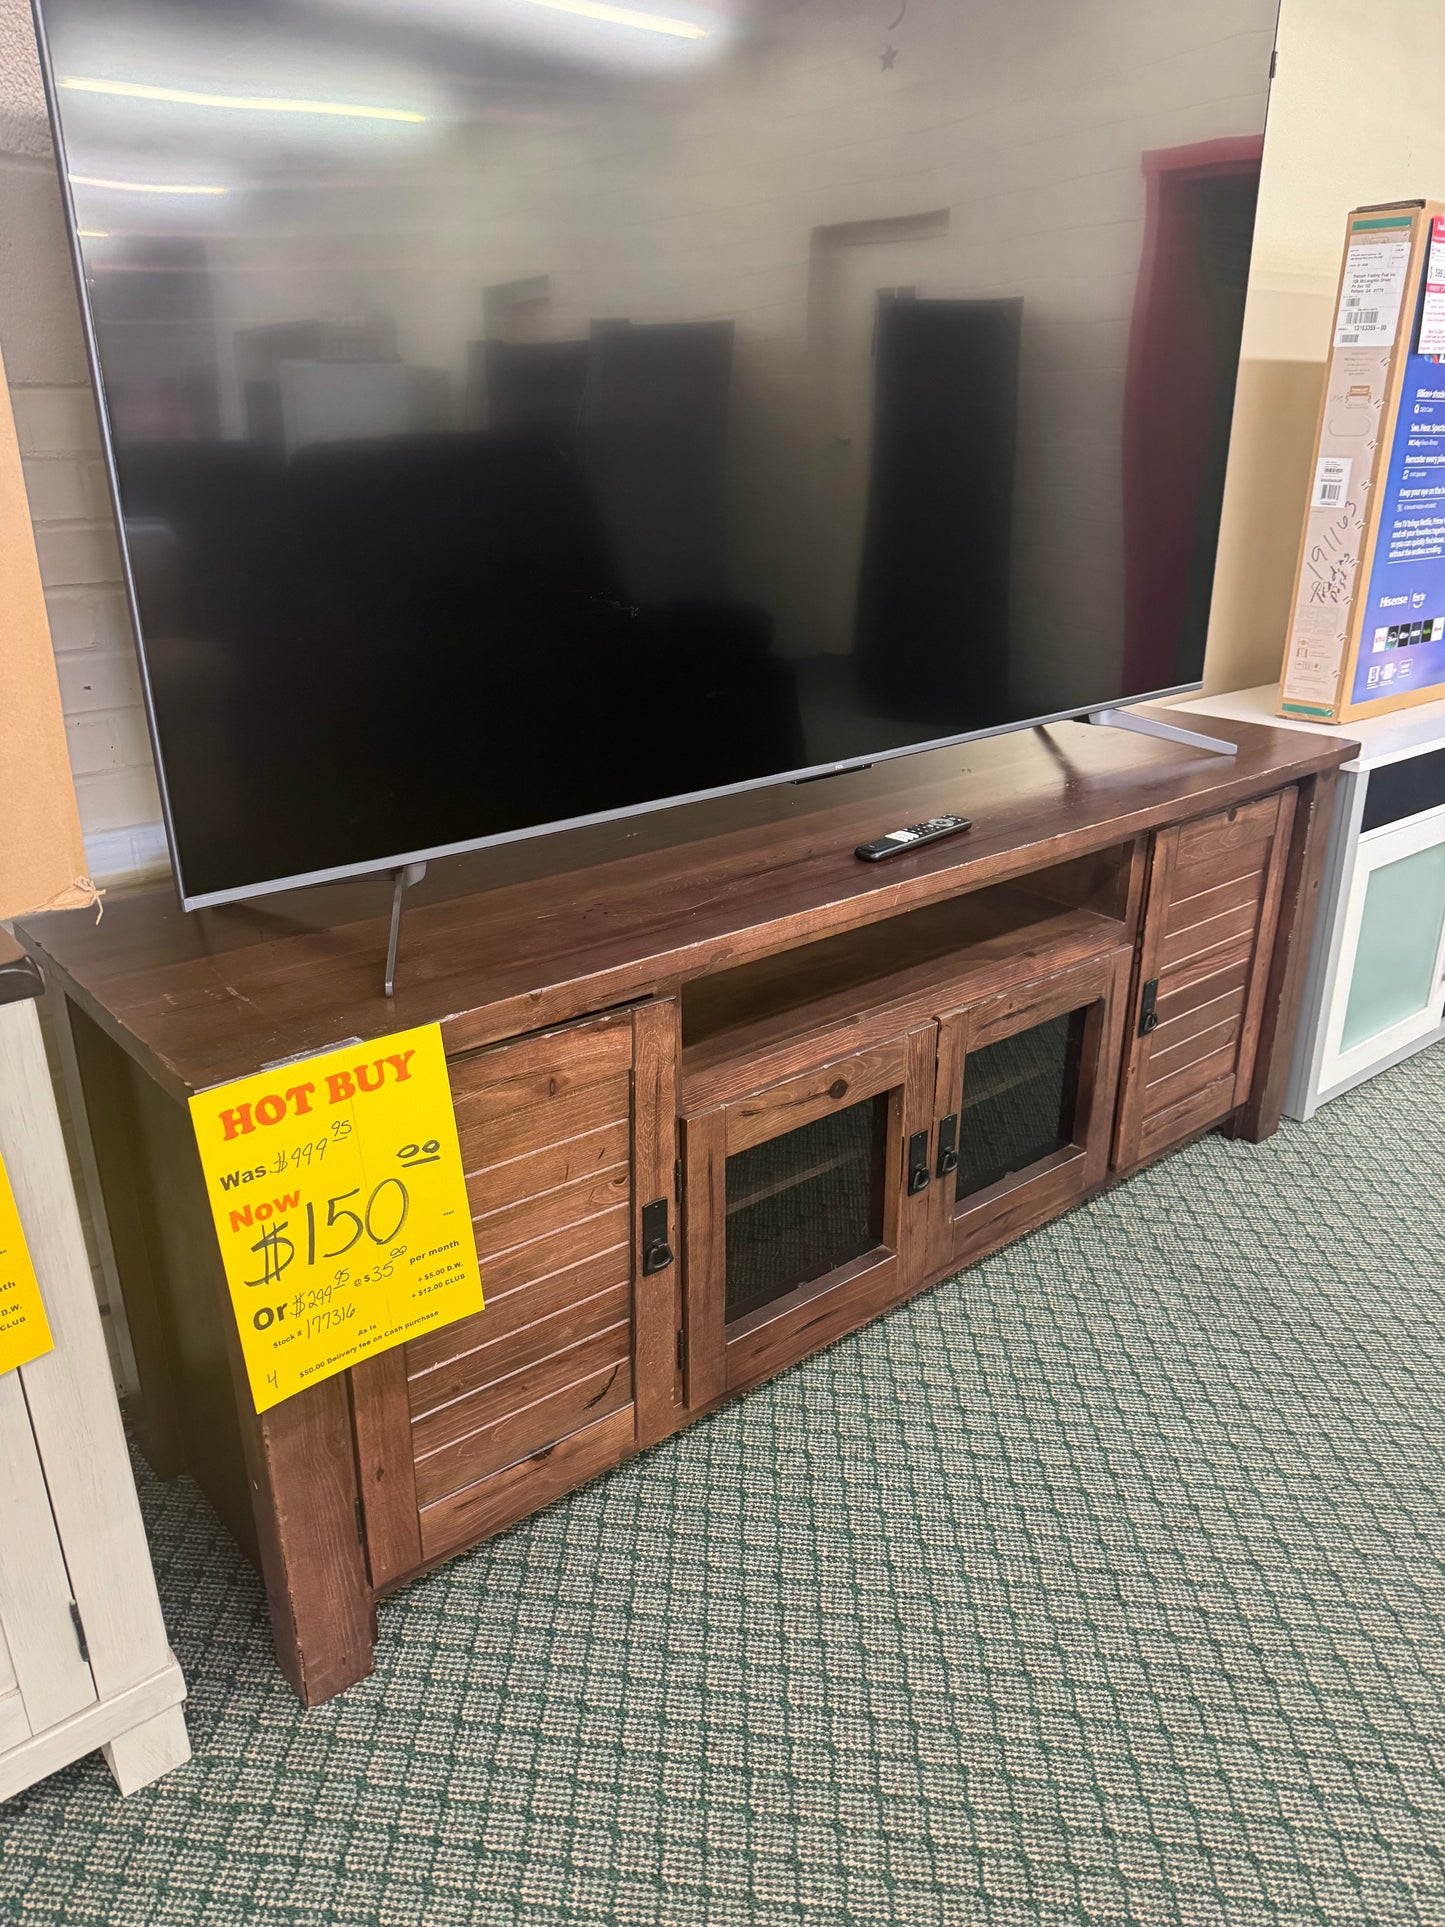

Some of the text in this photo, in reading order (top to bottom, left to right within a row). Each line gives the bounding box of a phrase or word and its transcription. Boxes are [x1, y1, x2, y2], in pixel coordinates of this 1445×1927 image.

[1379, 595, 1408, 608] Hisense
[218, 1049, 416, 1141] HOT BUY
[219, 1163, 267, 1191] Was
[228, 1189, 301, 1233] Now
[252, 1302, 288, 1331] Or
[409, 1252, 426, 1266] per
[428, 1239, 460, 1256] month
[418, 1282, 443, 1297] $12.00
[444, 1273, 465, 1286] CLUB
[424, 1267, 445, 1280] $5.00
[0, 1316, 26, 1331] CLUB
[357, 1327, 368, 1337] As
[272, 1333, 296, 1349] Stock
[299, 1310, 439, 1379] $50.00 Delivery fee on Cash purchase
